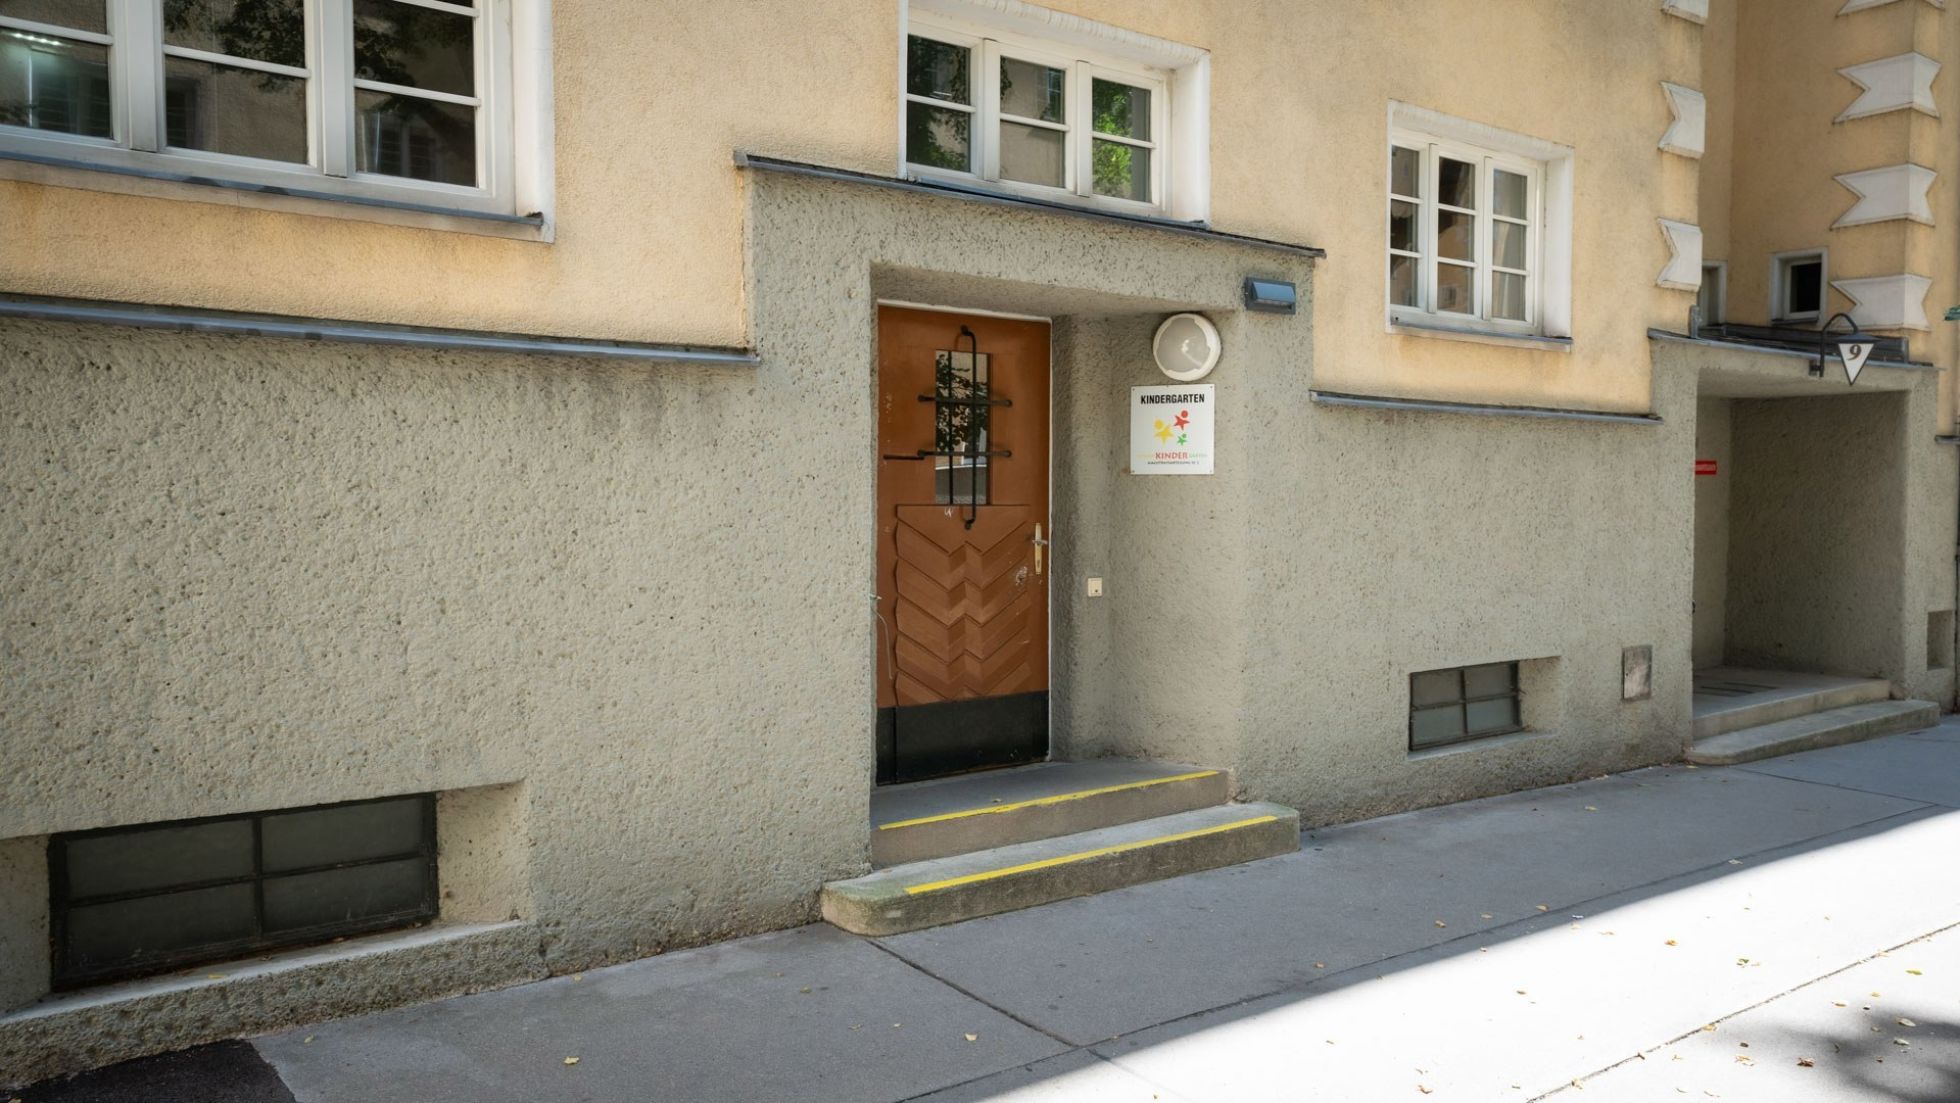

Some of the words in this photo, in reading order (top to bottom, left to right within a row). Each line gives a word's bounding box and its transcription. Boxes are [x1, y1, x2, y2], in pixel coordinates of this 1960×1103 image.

[1847, 344, 1862, 361] 9
[1140, 393, 1205, 405] KINDERGARTEN
[1155, 451, 1188, 460] KINDER
